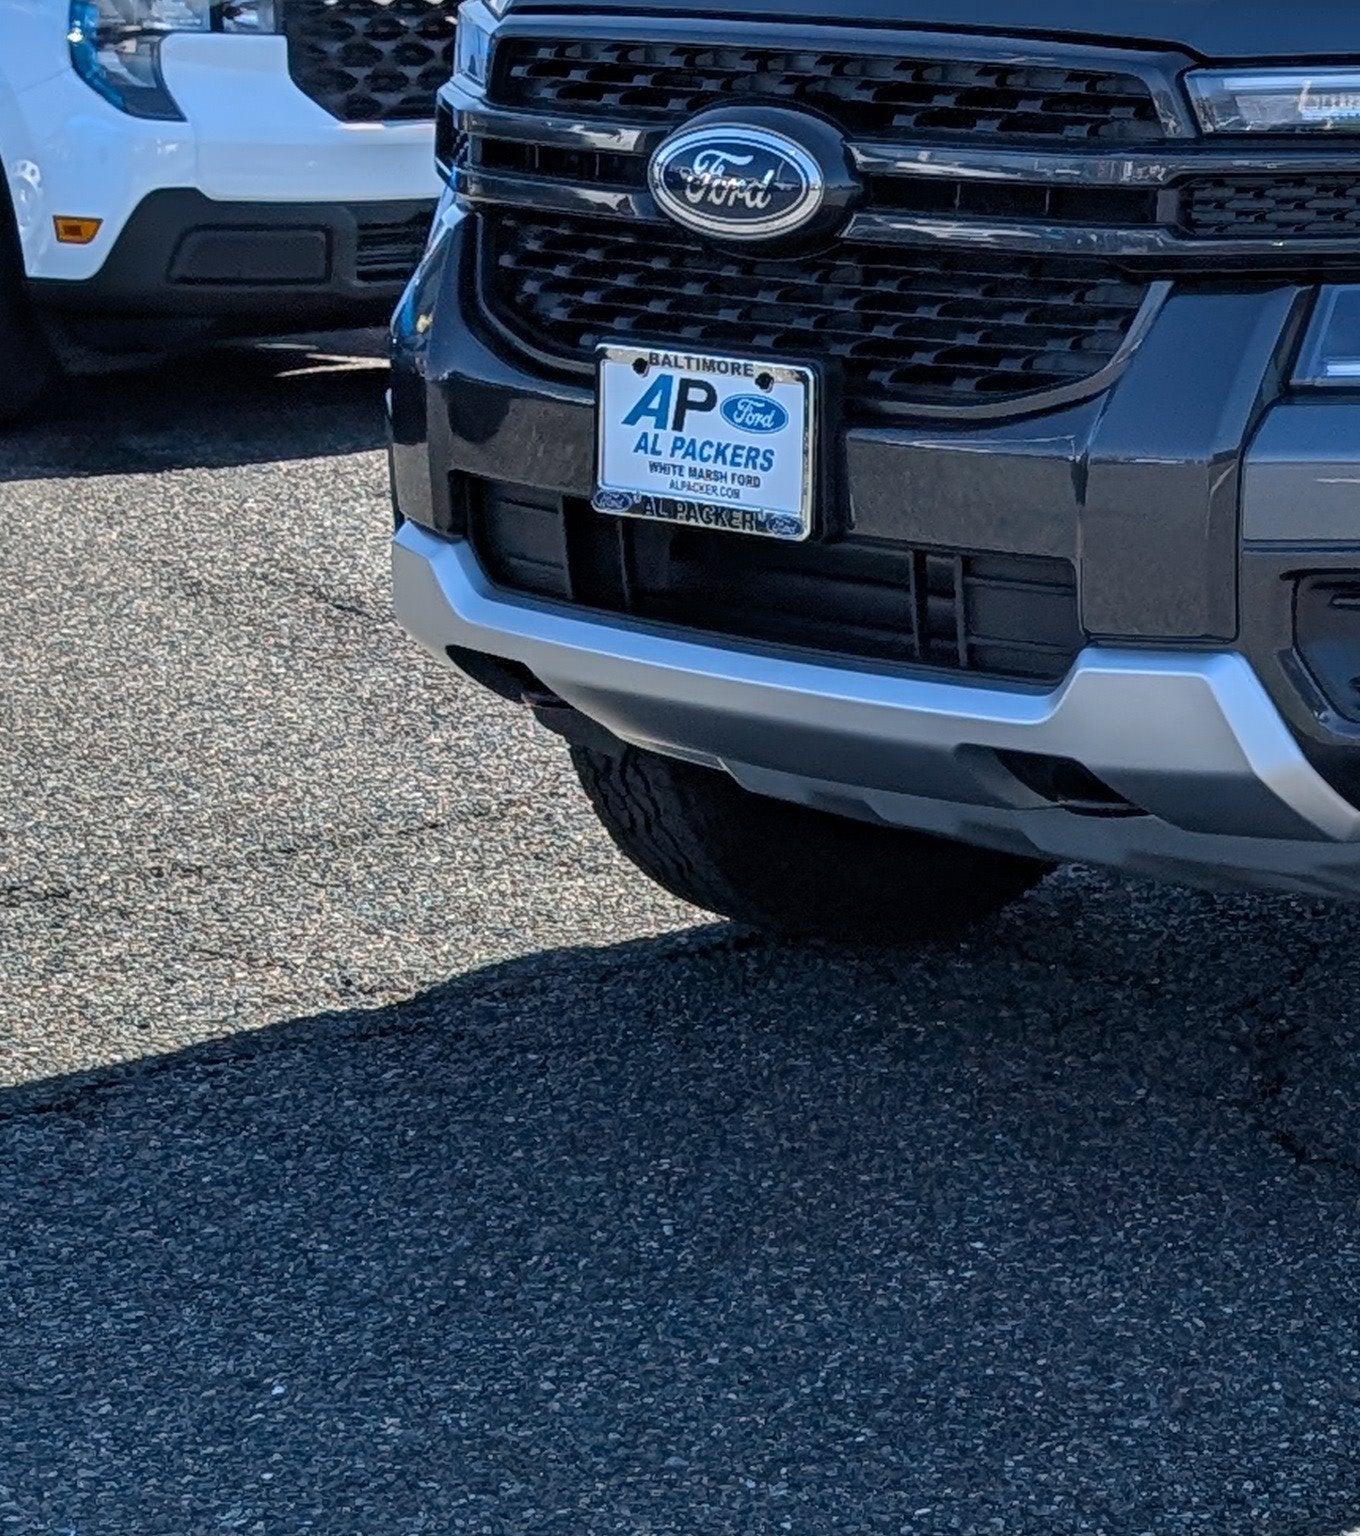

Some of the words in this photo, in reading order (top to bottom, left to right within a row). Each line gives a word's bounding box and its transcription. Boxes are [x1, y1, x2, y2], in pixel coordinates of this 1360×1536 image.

[685, 149, 774, 208] Ford
[650, 352, 754, 378] BALTIMORE
[621, 373, 717, 432] AP
[733, 397, 775, 428] Ford
[633, 432, 662, 457] AL
[670, 436, 775, 472] PACKERS
[649, 461, 684, 477] WHITE
[688, 467, 727, 483] MARSH
[731, 473, 761, 488] FORD
[644, 495, 668, 516] AL
